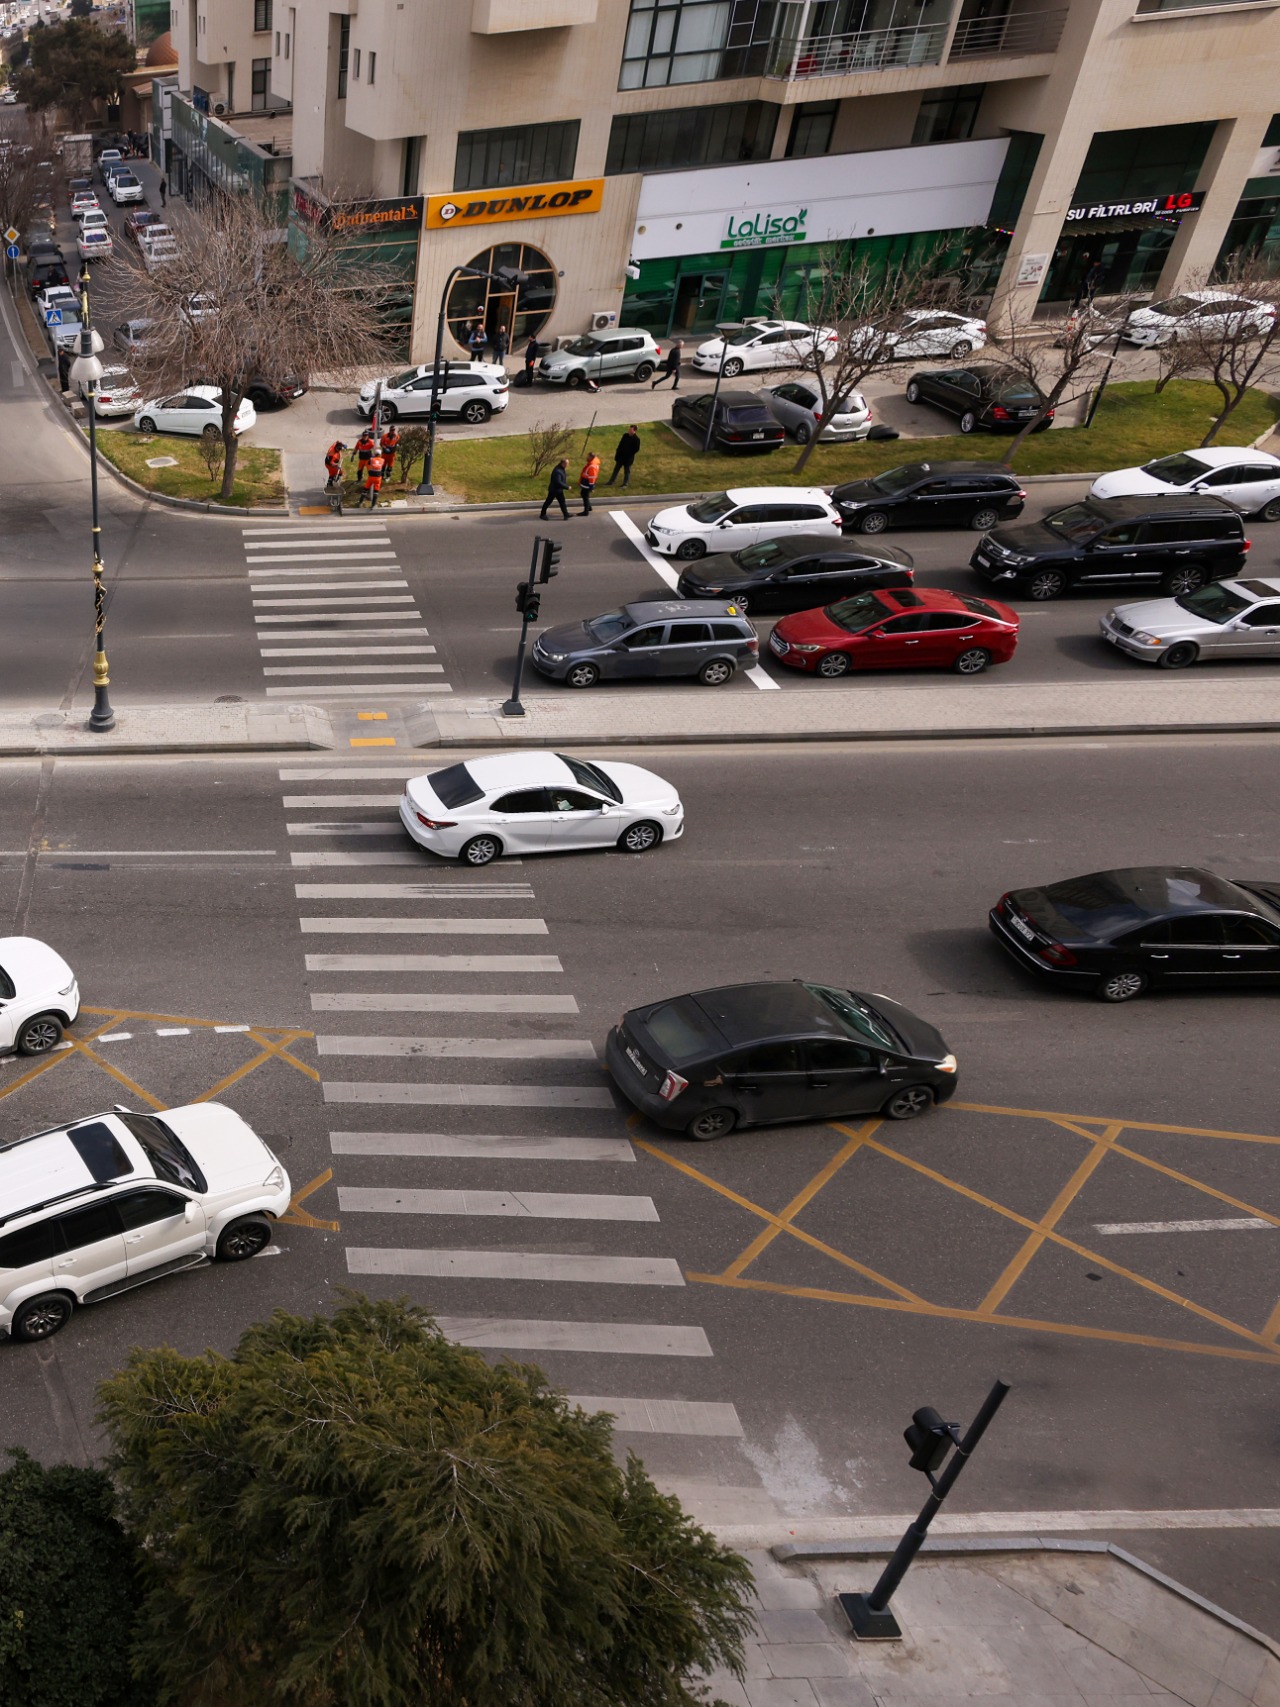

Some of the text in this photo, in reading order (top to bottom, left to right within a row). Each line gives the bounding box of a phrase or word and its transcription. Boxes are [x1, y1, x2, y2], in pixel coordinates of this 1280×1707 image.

[462, 189, 593, 218] DUNLOP
[1066, 208, 1086, 221] SU
[1088, 199, 1158, 219] FİLTRLƏRİ
[1164, 193, 1193, 210] LG
